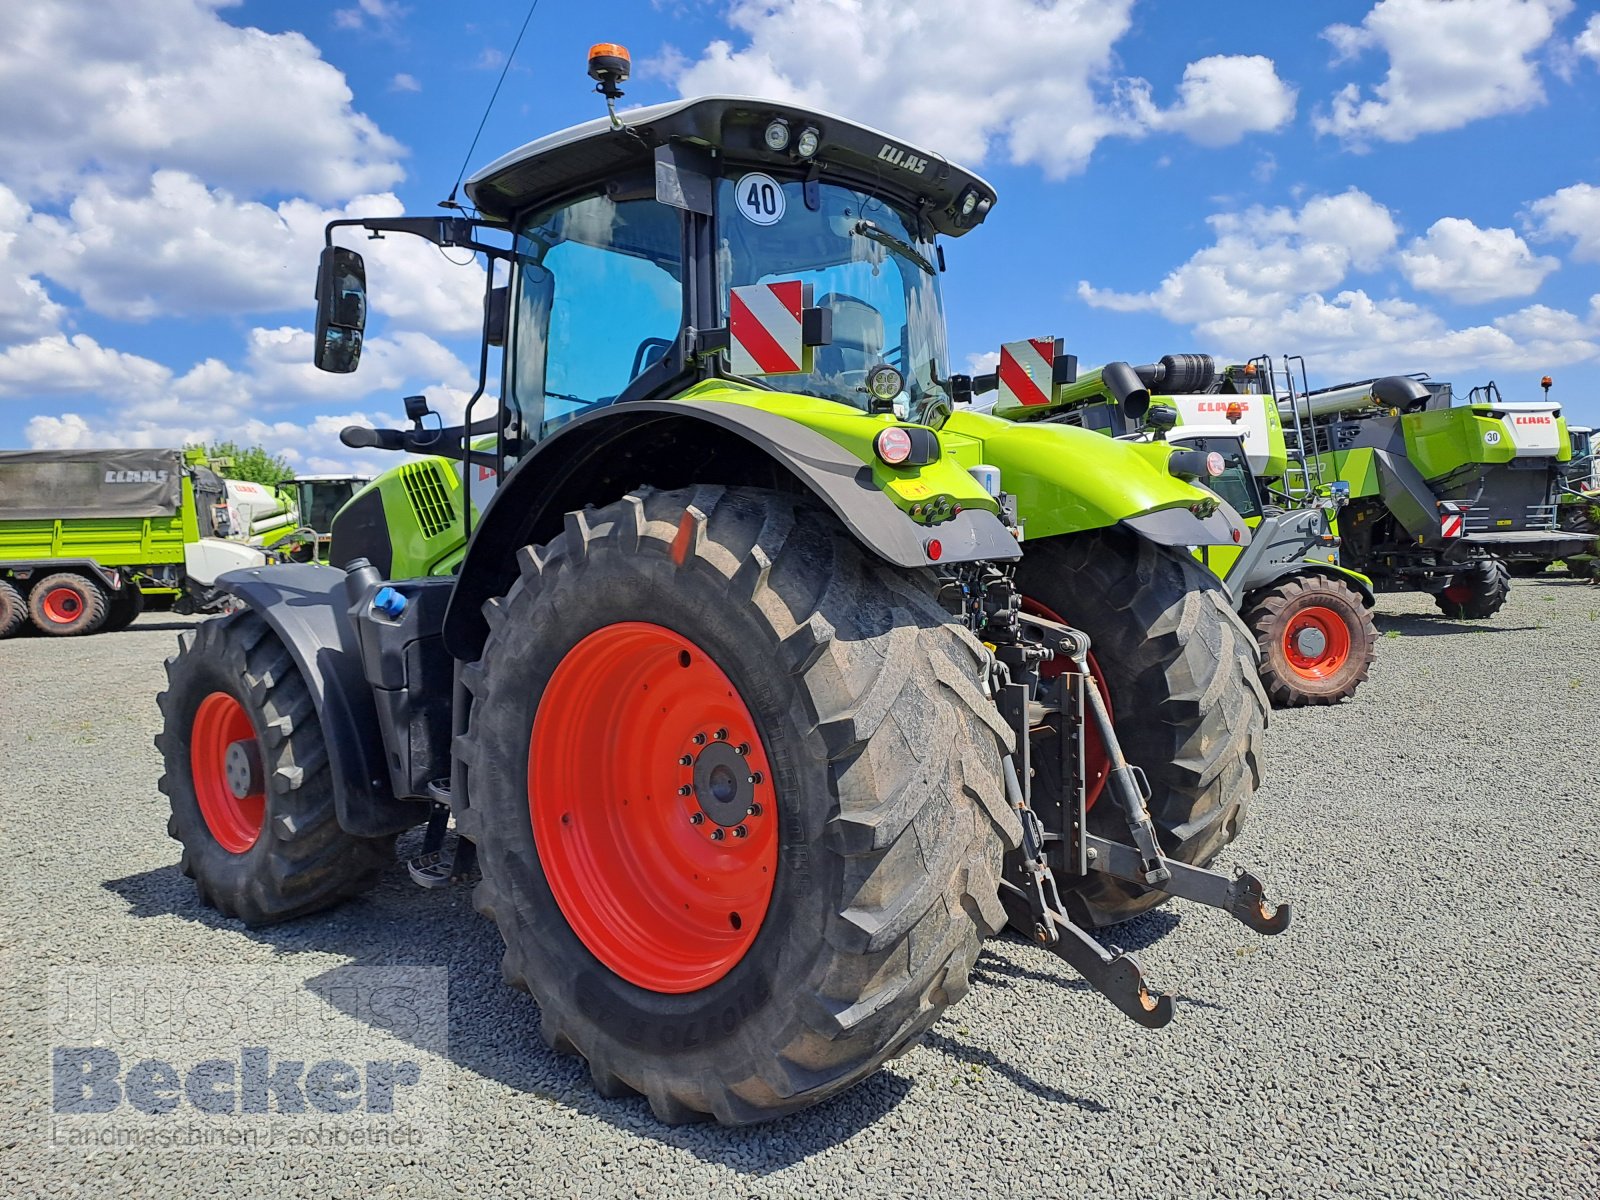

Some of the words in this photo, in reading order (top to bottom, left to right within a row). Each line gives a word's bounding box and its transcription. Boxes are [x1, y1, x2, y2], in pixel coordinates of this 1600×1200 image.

[746, 183, 776, 215] 40
[1198, 402, 1249, 412] CLAS
[1515, 416, 1551, 425] CLAAS
[1486, 432, 1499, 442] 30
[104, 469, 169, 483] CLAAS
